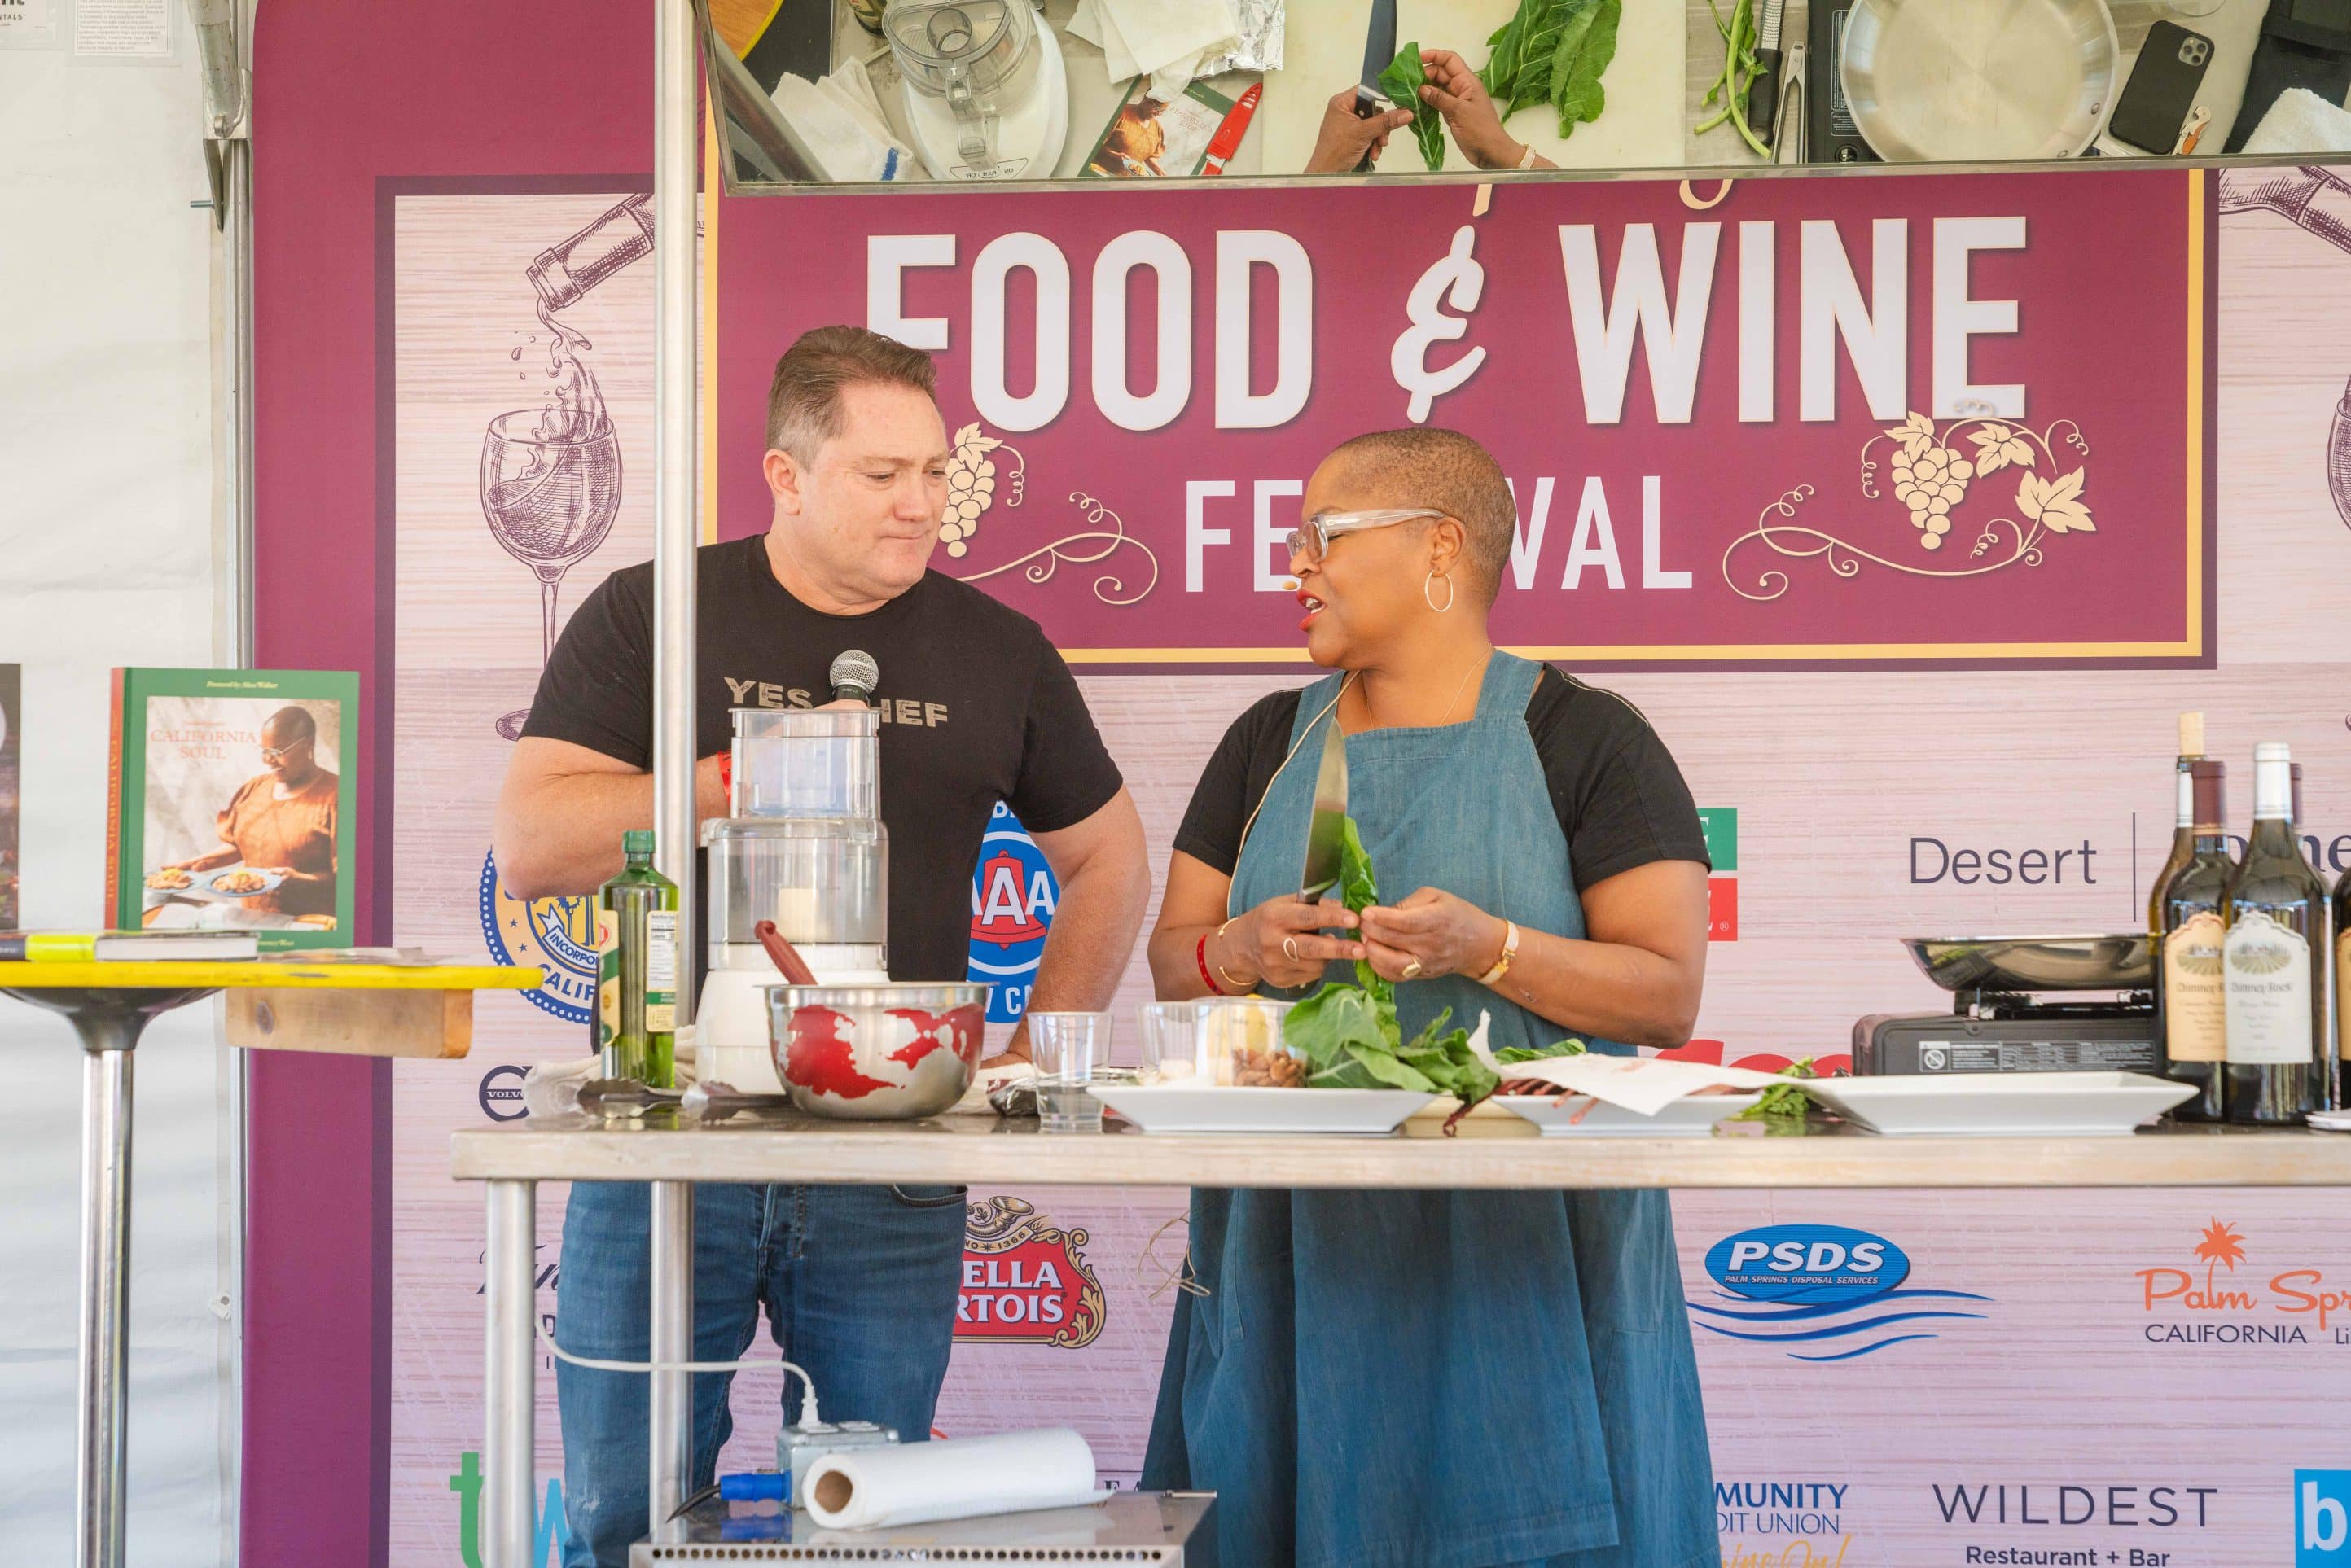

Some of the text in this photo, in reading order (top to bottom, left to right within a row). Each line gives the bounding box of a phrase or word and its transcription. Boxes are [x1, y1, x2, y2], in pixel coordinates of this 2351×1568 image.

[867, 217, 2026, 432] FOOD & WINE
[1186, 475, 1693, 593] FEVAL
[724, 677, 814, 709] YES
[151, 729, 257, 743] CALIFORNIA
[180, 747, 227, 760] SOUL
[1910, 837, 2097, 885] Desert
[549, 933, 598, 966] INCORPO
[998, 1231, 1026, 1250] 1366
[1727, 1242, 1887, 1272] PSDS
[963, 1260, 1063, 1289] ELLA
[1724, 1275, 1879, 1285] PALM SPRINGS DISPOSAL SERVICES
[957, 1294, 1064, 1322] RTOIS
[2134, 1268, 2351, 1331] Palm Spr
[2145, 1324, 2349, 1344] CALIFORNIA Li
[1715, 1483, 1849, 1509] MUNITY
[1932, 1484, 2217, 1527] WILDEST
[1717, 1512, 1840, 1535] DIT UNION
[2302, 1481, 2348, 1551] b
[1966, 1546, 2098, 1566] Restaurant
[2129, 1548, 2170, 1567] Bar
